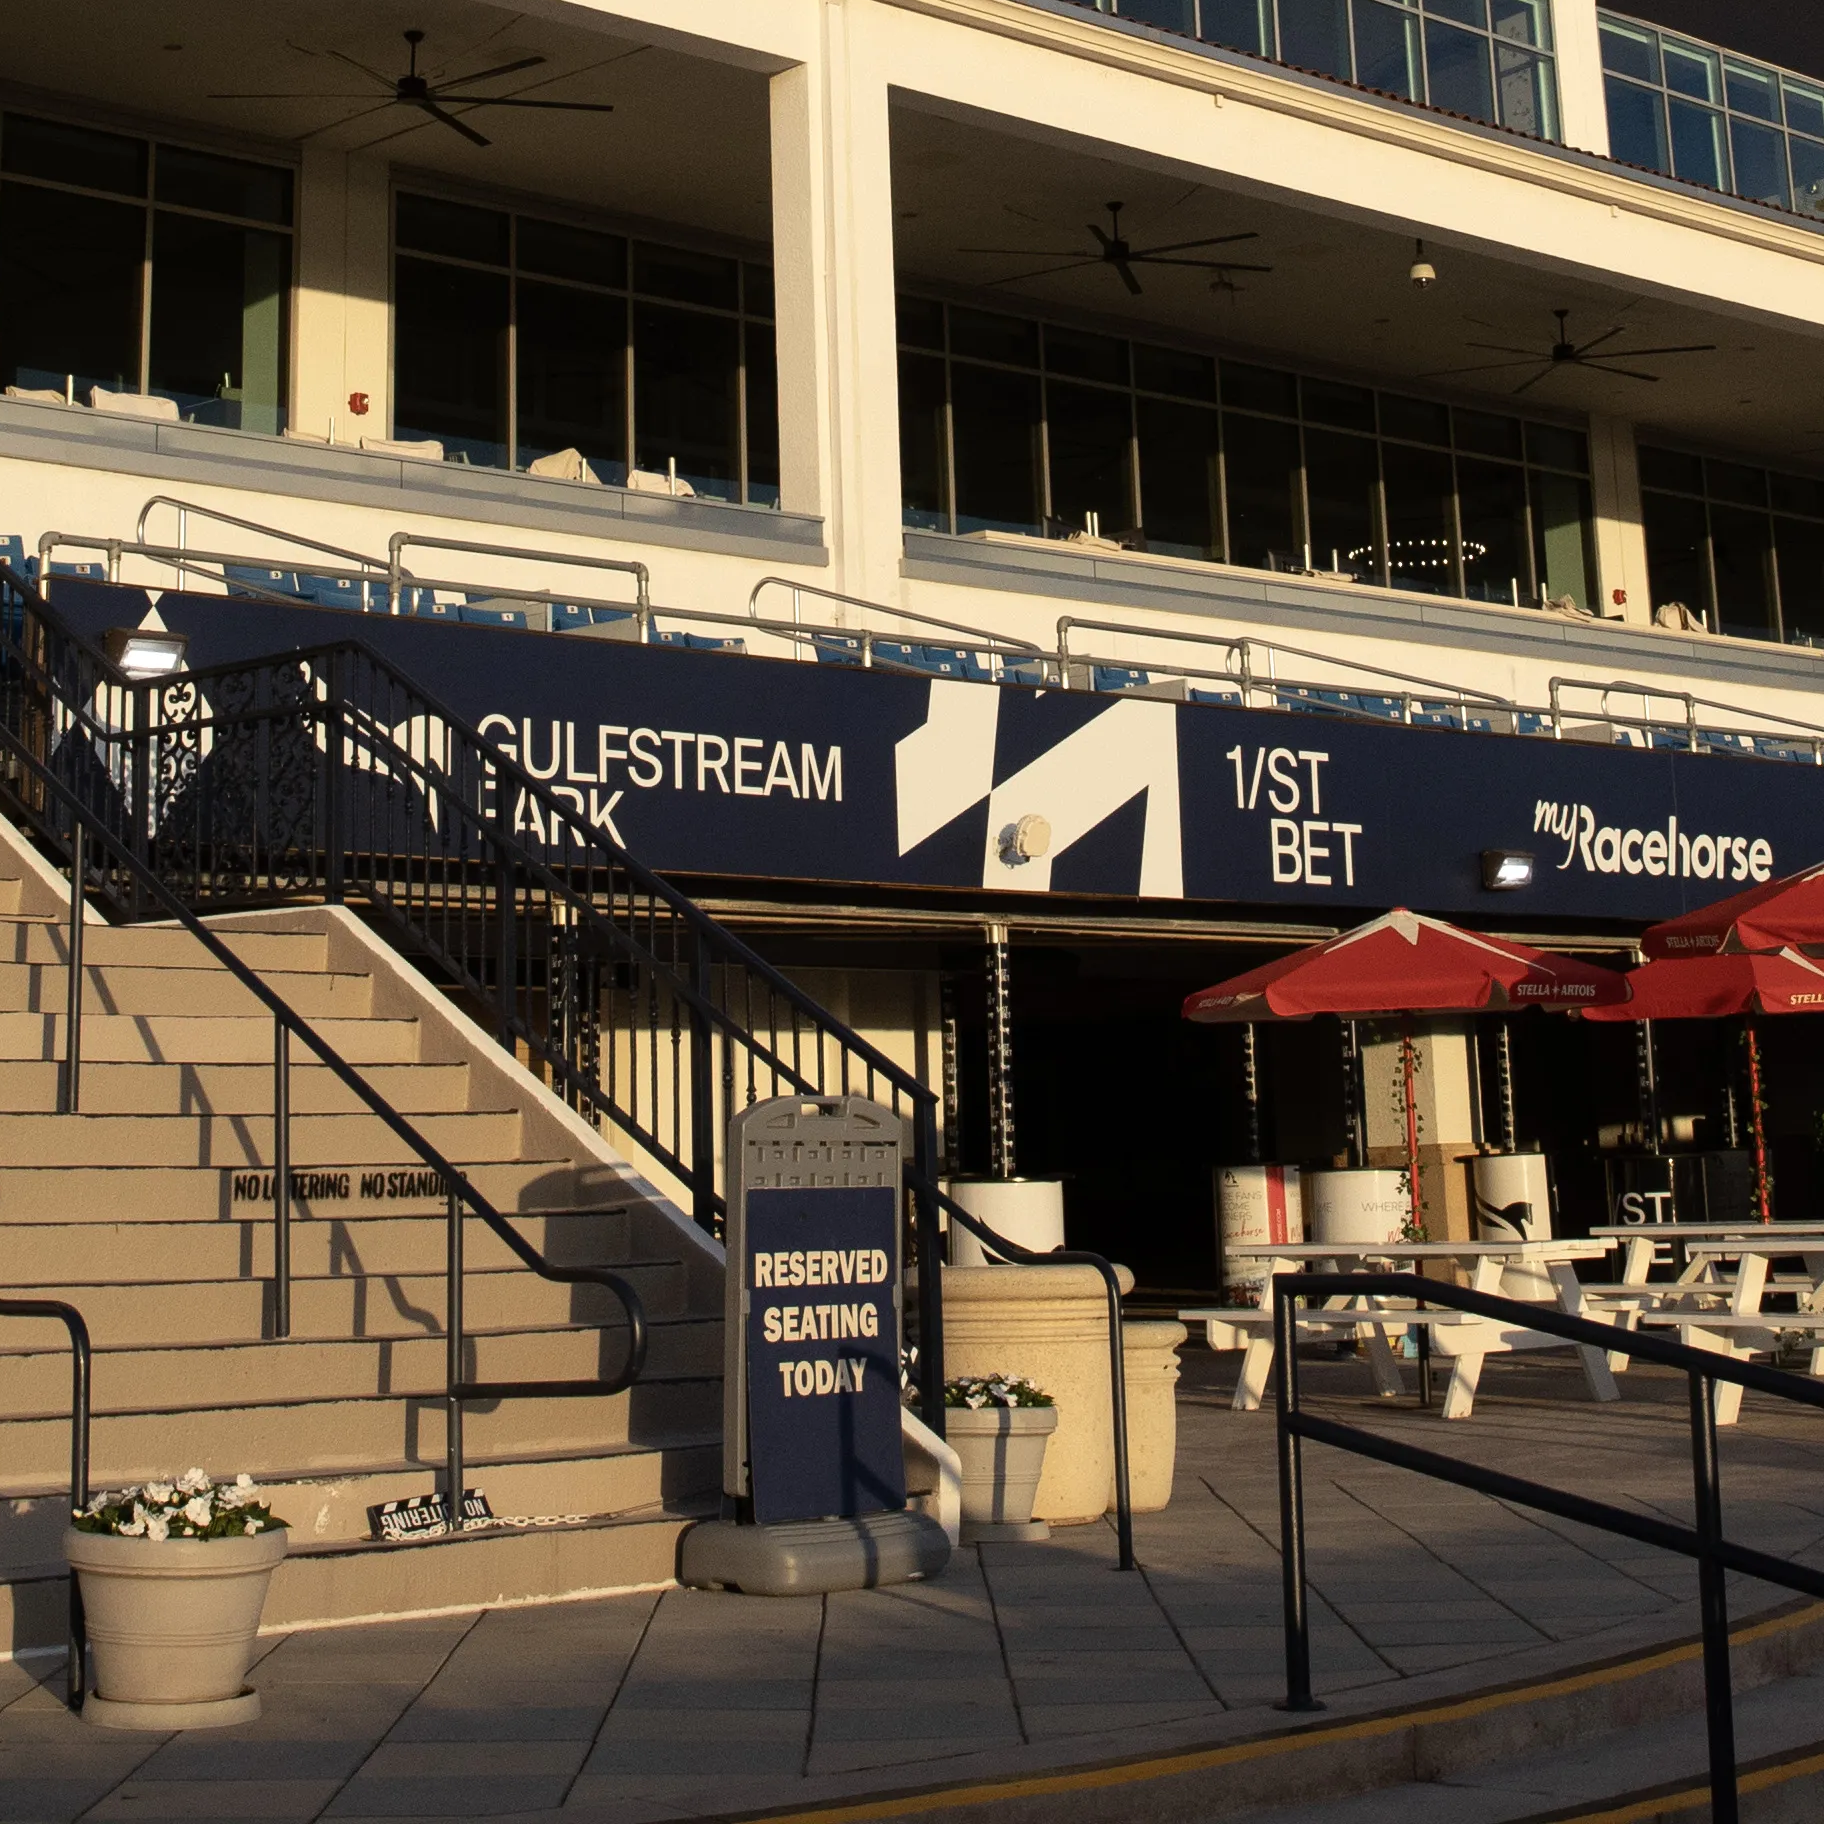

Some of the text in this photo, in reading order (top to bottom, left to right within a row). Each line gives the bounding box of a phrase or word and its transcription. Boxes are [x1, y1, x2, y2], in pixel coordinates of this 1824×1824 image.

[476, 713, 843, 803] GULFSTREAM
[1226, 744, 1330, 815] 1/ST
[1270, 818, 1363, 887] BET
[1533, 799, 1774, 883] myRacehorse
[1517, 983, 1597, 998] STELLA ARTOIS
[233, 1171, 467, 1201] NO LOTERING NO STANDI
[754, 1249, 888, 1288] RESERVED
[763, 1302, 878, 1343] SEATING
[779, 1357, 868, 1398] TODAY
[464, 1498, 487, 1517] NO
